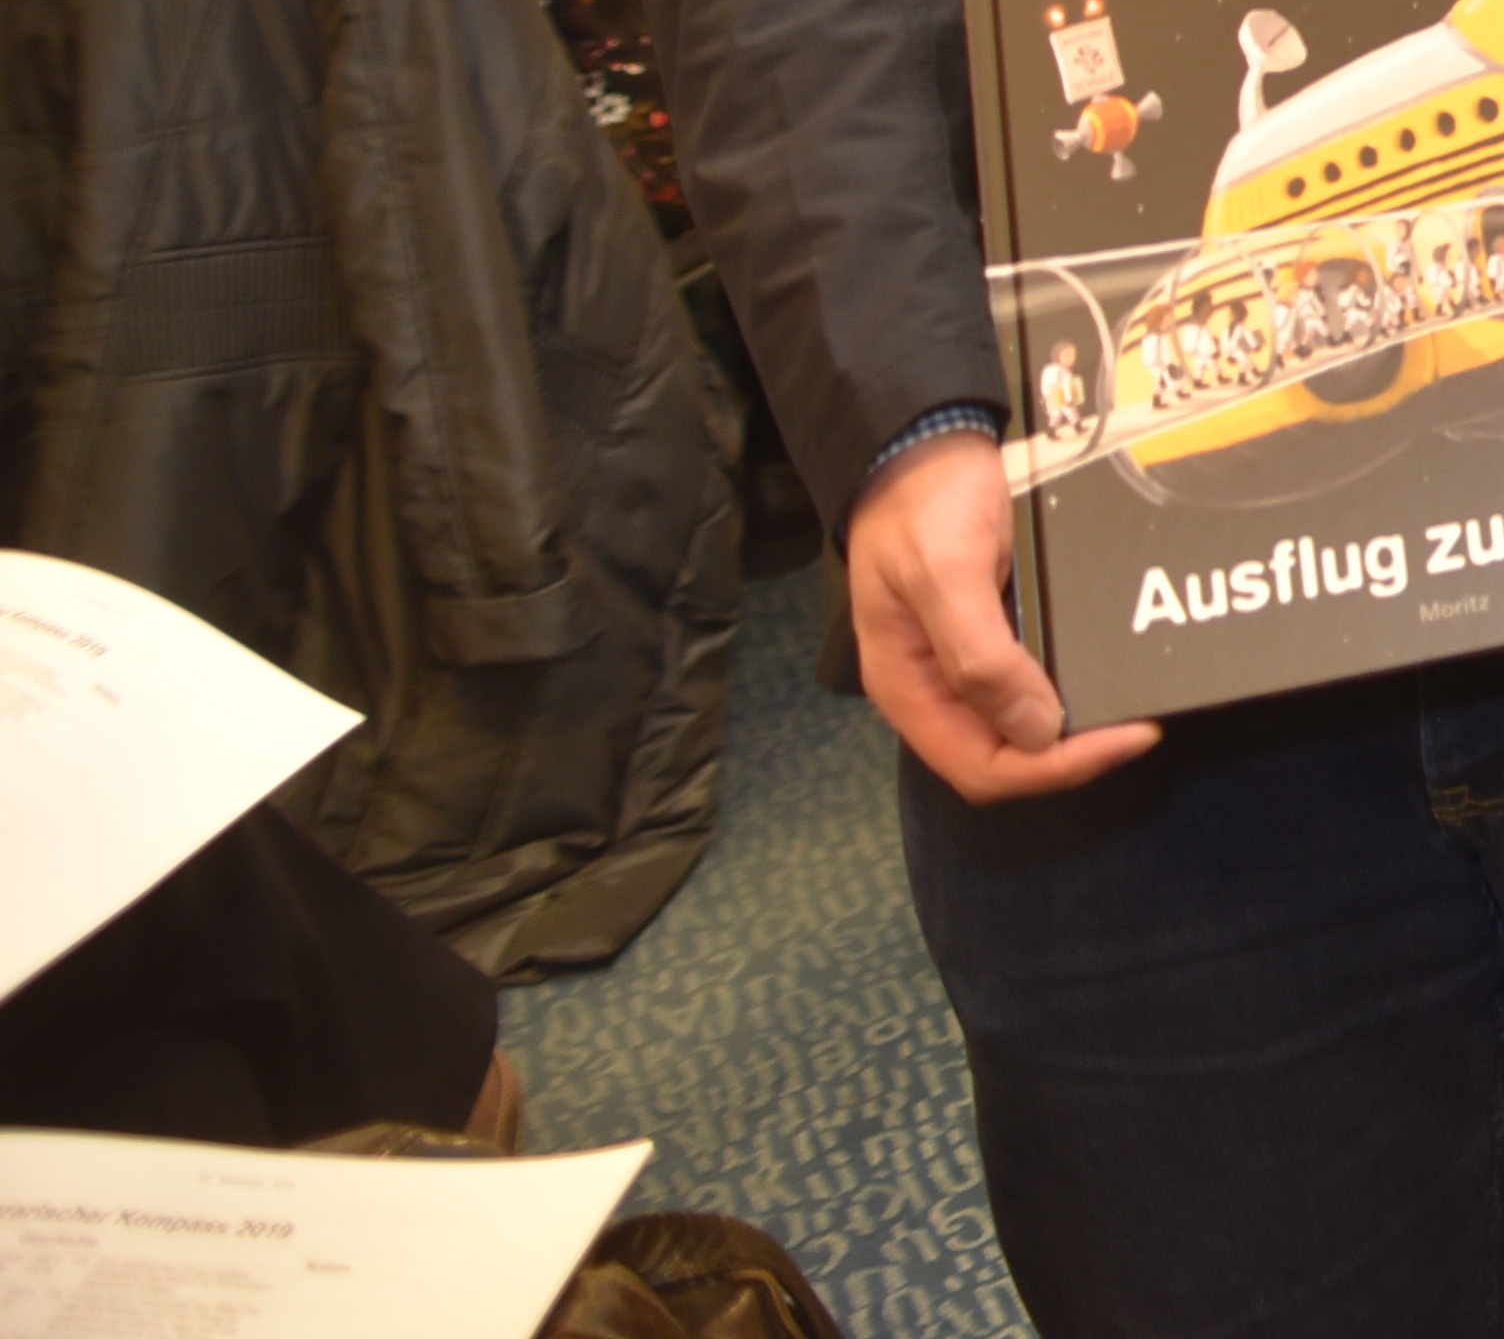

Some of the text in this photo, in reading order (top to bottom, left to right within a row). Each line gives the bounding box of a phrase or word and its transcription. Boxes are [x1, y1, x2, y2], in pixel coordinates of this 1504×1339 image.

[1131, 536, 1408, 633] Ausflug
[1419, 593, 1490, 624] Moritz
[116, 1209, 295, 1239] Kompass 2019
